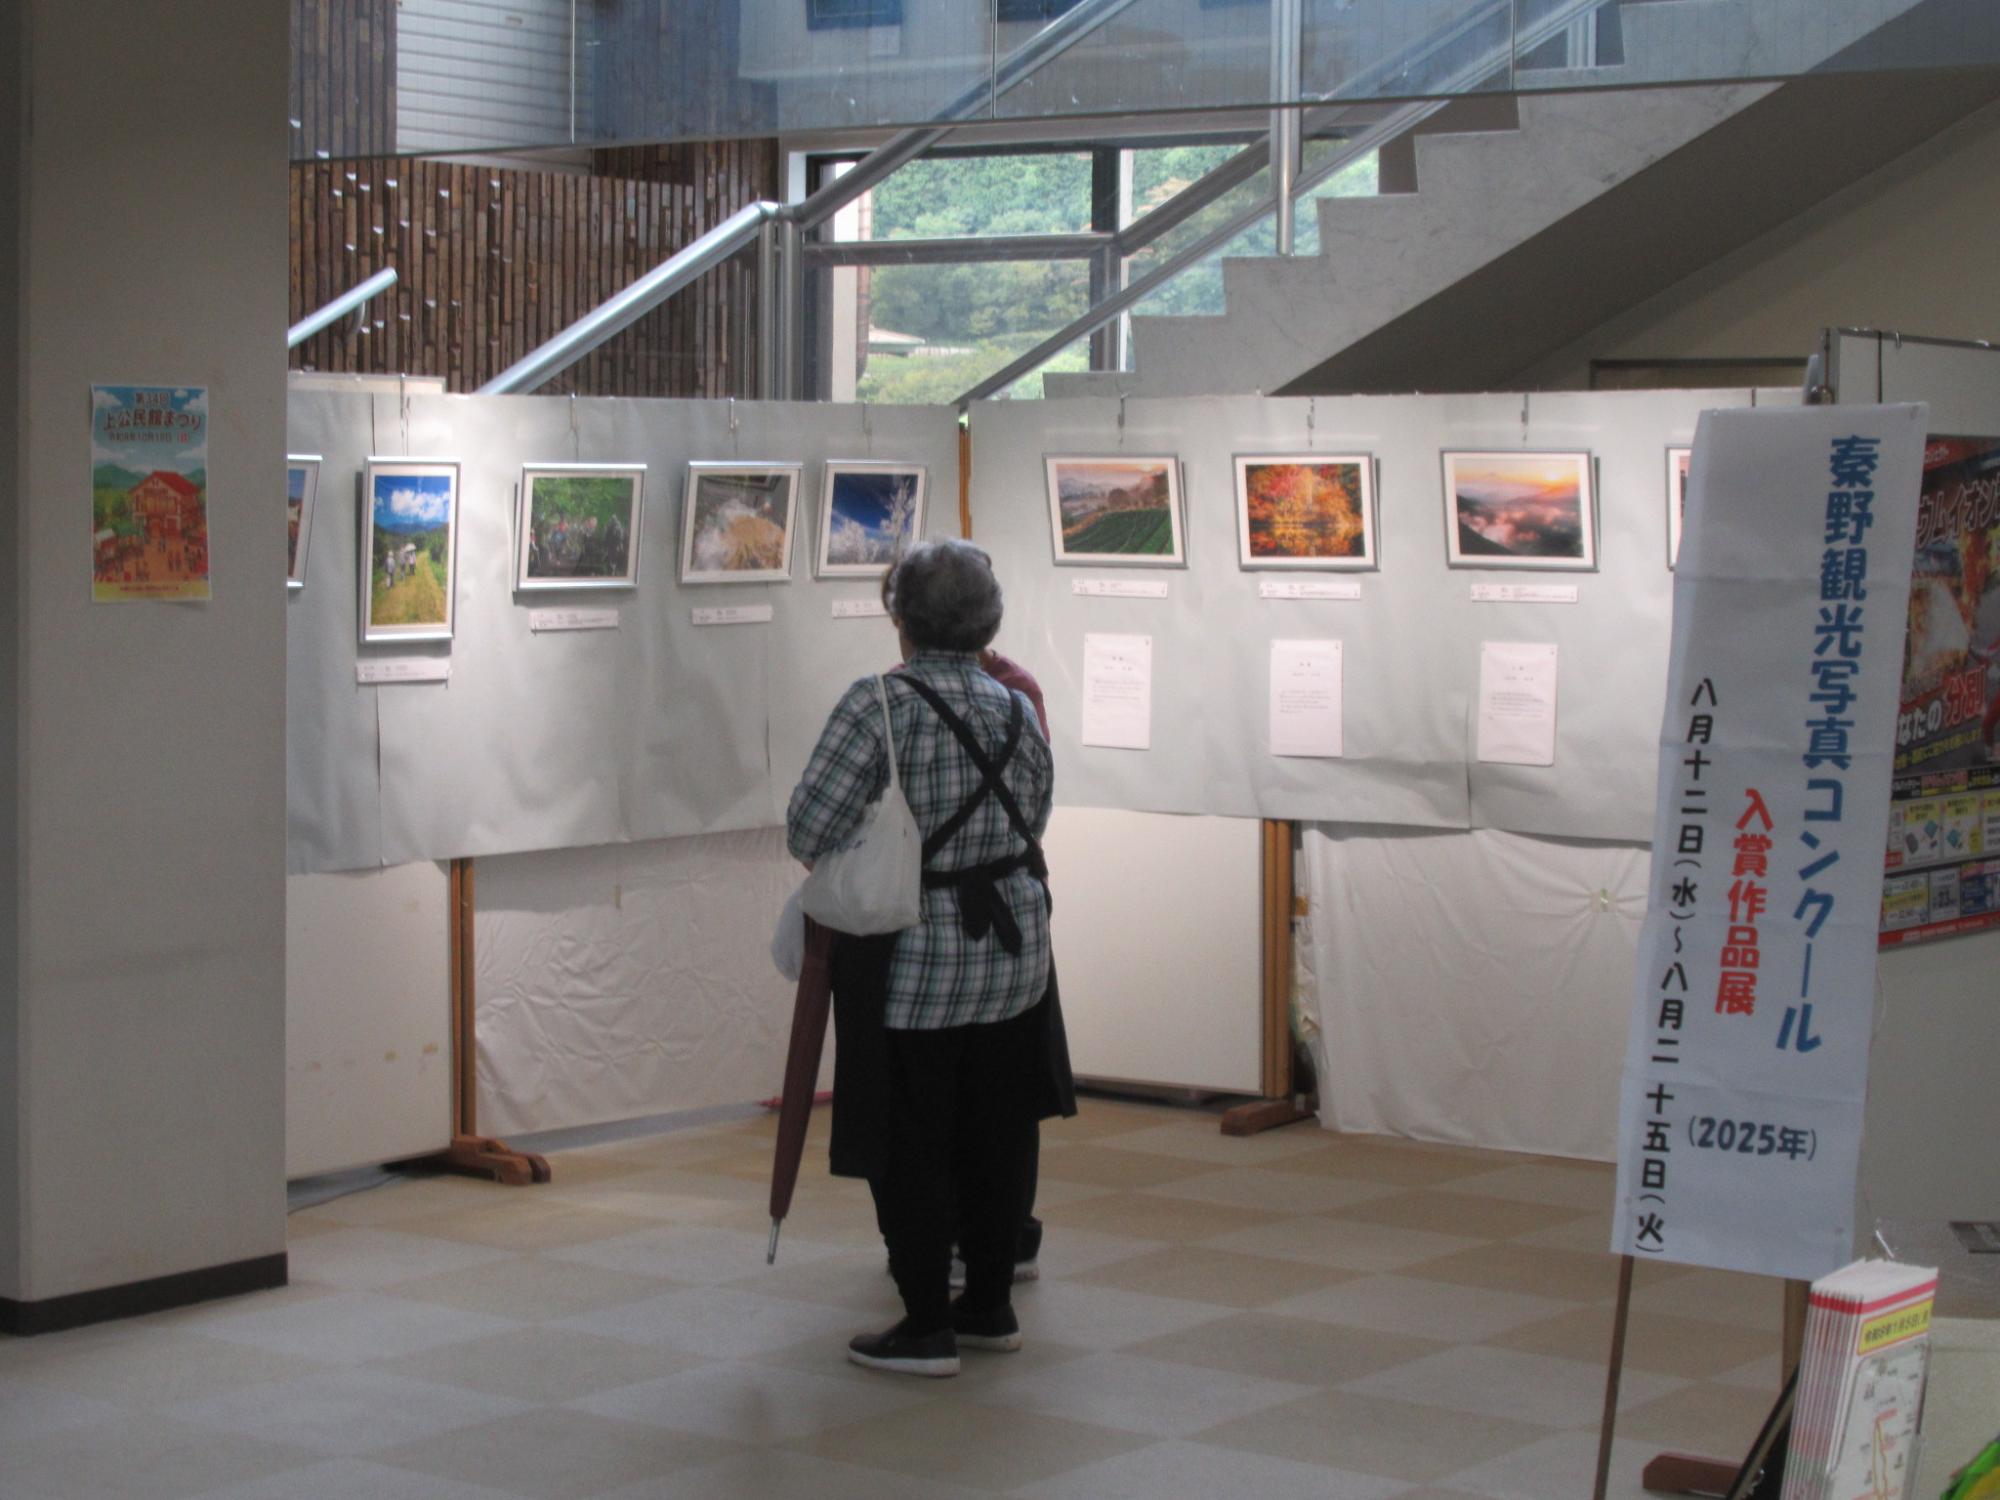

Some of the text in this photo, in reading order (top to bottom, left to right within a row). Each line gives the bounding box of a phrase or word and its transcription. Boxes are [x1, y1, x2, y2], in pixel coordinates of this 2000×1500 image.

[103, 408, 202, 431] 上公民館まつり
[1776, 434, 1882, 1053] 秦野観光写真コンクール
[1714, 788, 1776, 1016] 入賞作品展
[1688, 1115, 1818, 1162] (2025年)
